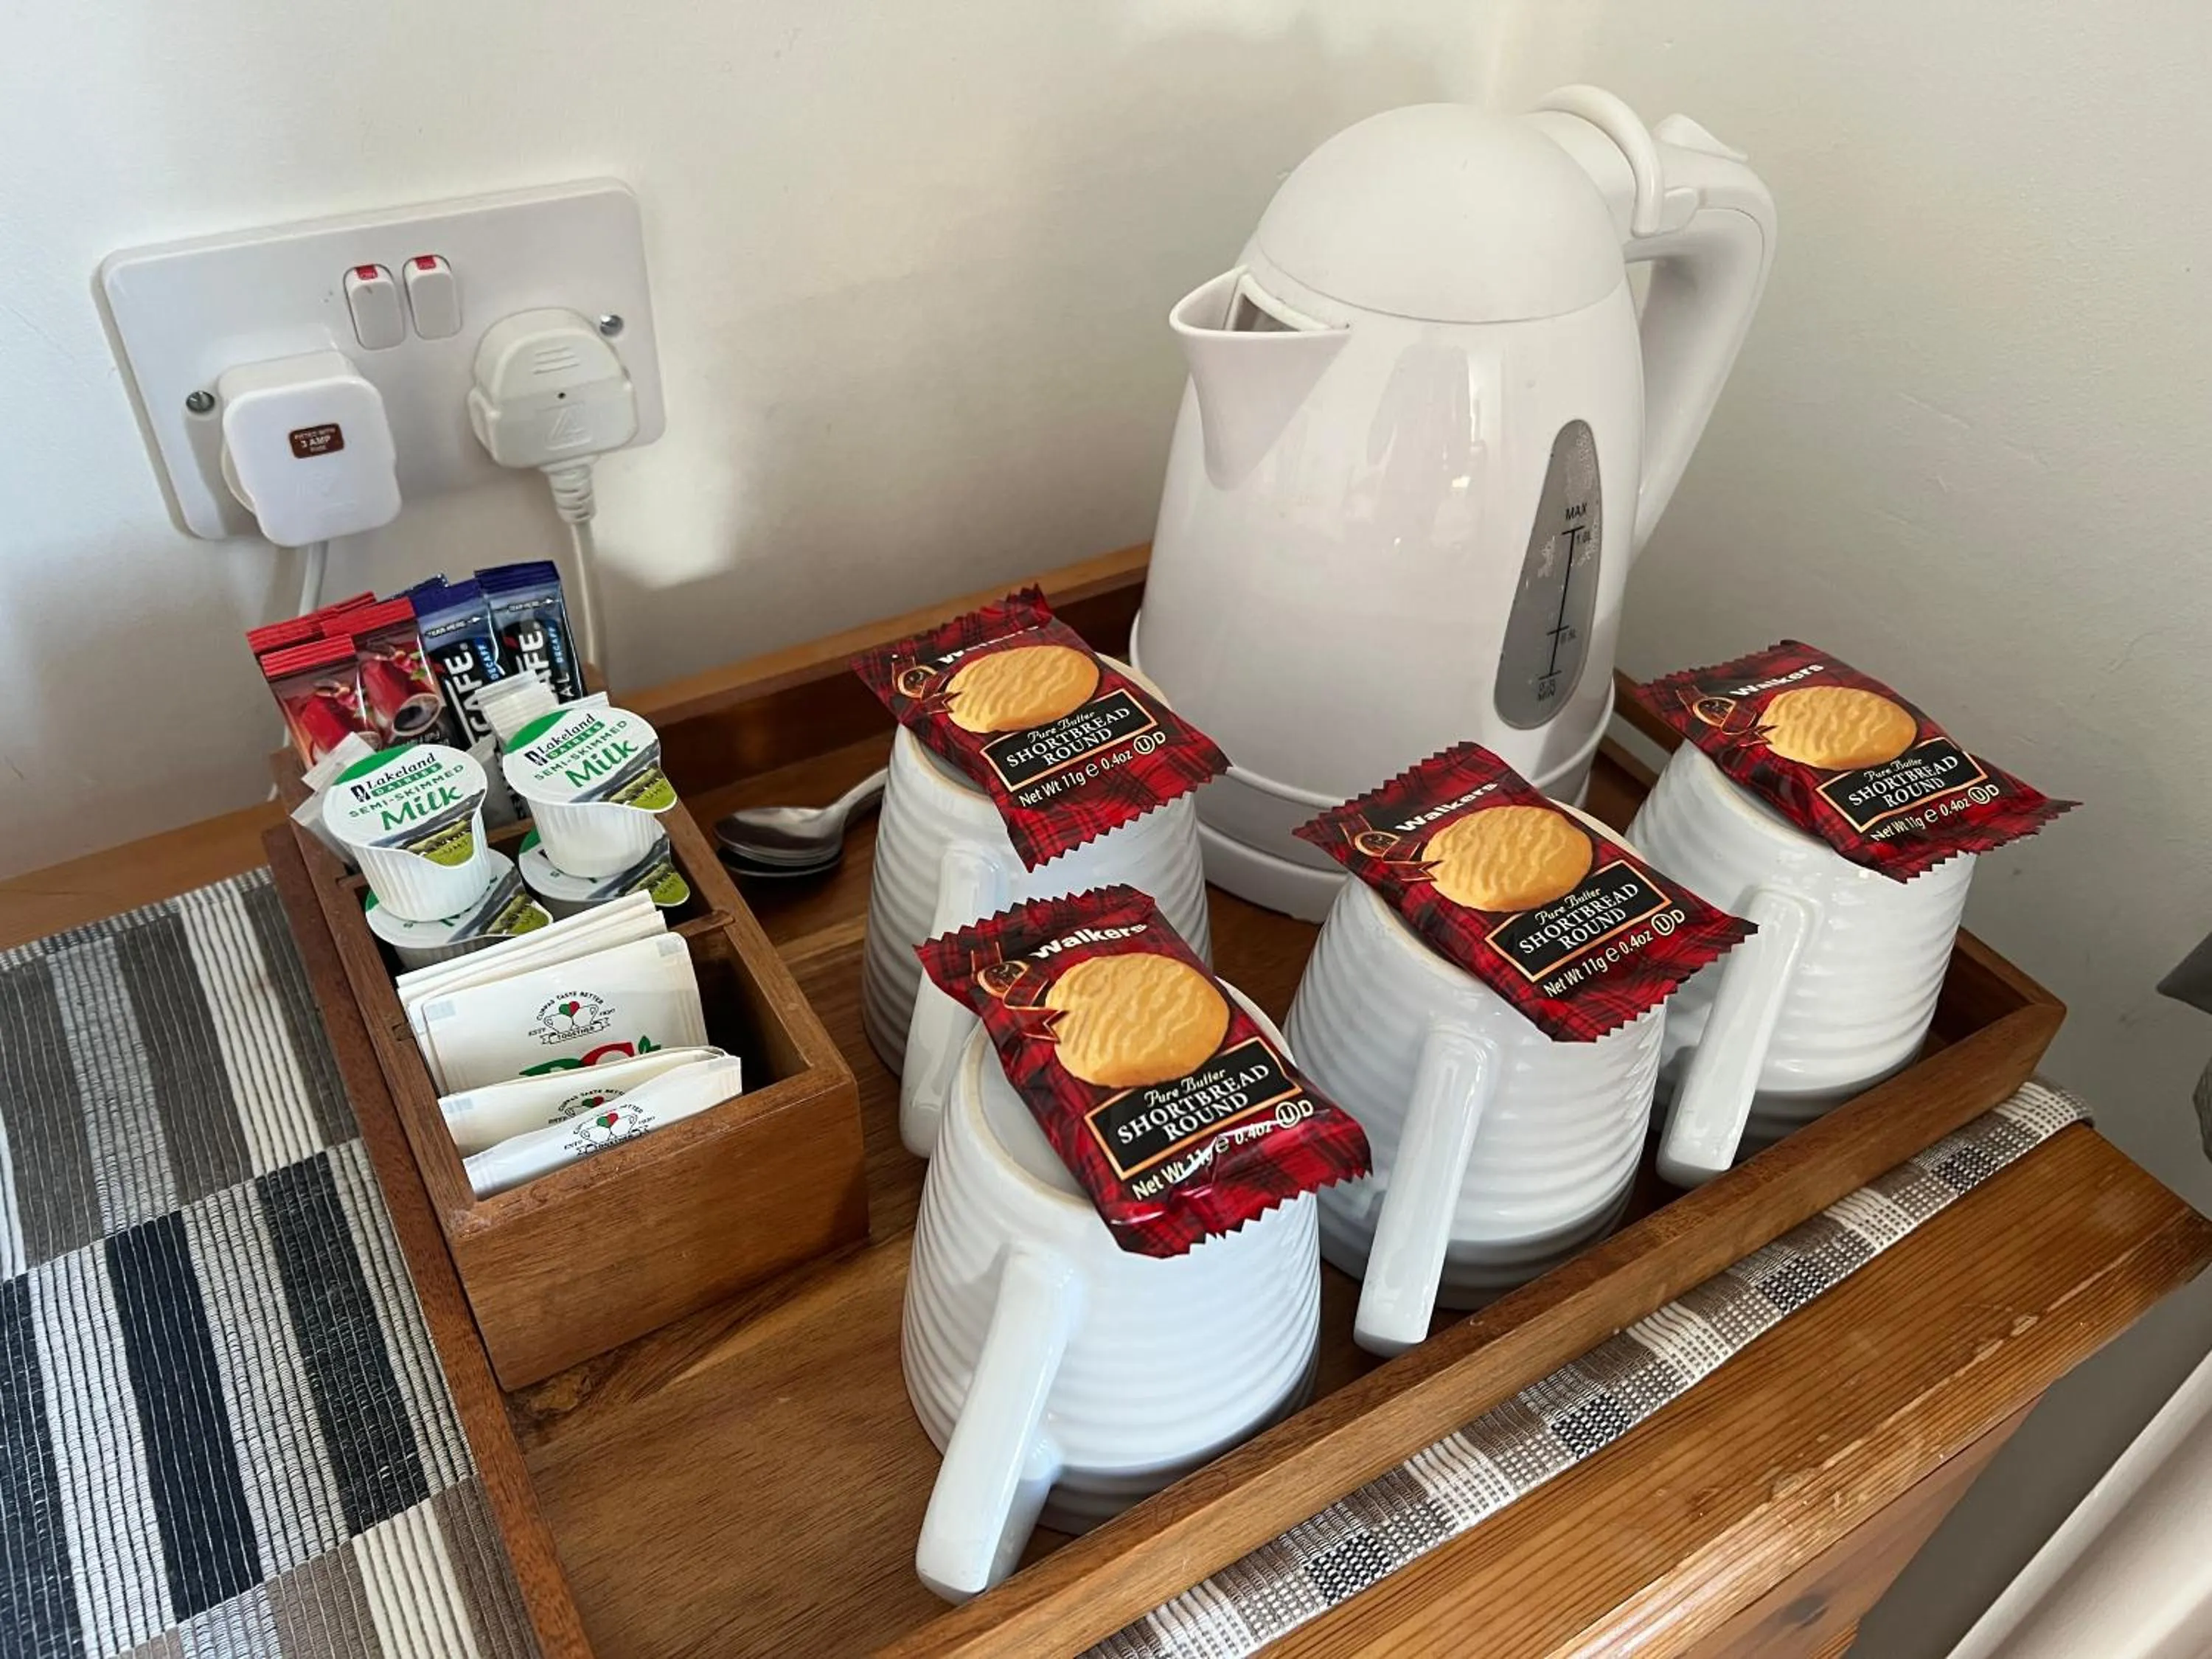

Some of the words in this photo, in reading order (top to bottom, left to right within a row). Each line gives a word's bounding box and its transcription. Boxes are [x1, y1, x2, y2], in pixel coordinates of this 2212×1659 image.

[310, 435, 331, 446] AMP
[1565, 502, 1587, 520] MAX
[535, 720, 627, 781] SEMI-SKIMMED
[537, 713, 597, 754] Lakeland
[1006, 707, 1131, 768] SHORTBREAD
[1027, 728, 1057, 744] Pure
[1042, 728, 1112, 766] ROUND
[366, 752, 436, 789] Lakeland
[565, 740, 639, 788] Milk
[1018, 790, 1041, 807] Net
[1041, 780, 1062, 798] Wt
[1062, 772, 1086, 787] 11g
[1101, 750, 1133, 771] 0.4oz
[1848, 755, 1958, 806] SHORTBREAD
[349, 764, 465, 818] SEMI-SKIMMED
[380, 785, 465, 831] Milk
[1395, 782, 1499, 831] Walkers
[1882, 778, 1945, 807] ROUND
[1870, 825, 1893, 842] Net
[1892, 819, 1909, 834] Wt
[1905, 815, 1925, 830] 11g
[1939, 799, 1971, 816] 0.4oz
[1519, 883, 1639, 954] SHORTBREAD
[1534, 906, 1566, 925] Pure
[1557, 908, 1626, 950] ROUND
[1028, 923, 1148, 959] Walkers
[1543, 978, 1566, 998] Net
[1564, 967, 1585, 986] Wt
[1582, 958, 1608, 975] 11g
[1618, 930, 1654, 954] 0.4oz
[580, 991, 605, 1005] BETTER
[1118, 1064, 1270, 1144] SHORTBREAD
[1144, 1088, 1179, 1107] Pure
[1180, 1069, 1226, 1093] Butter
[1162, 1092, 1248, 1142] ROUND
[1132, 1175, 1164, 1200] Net
